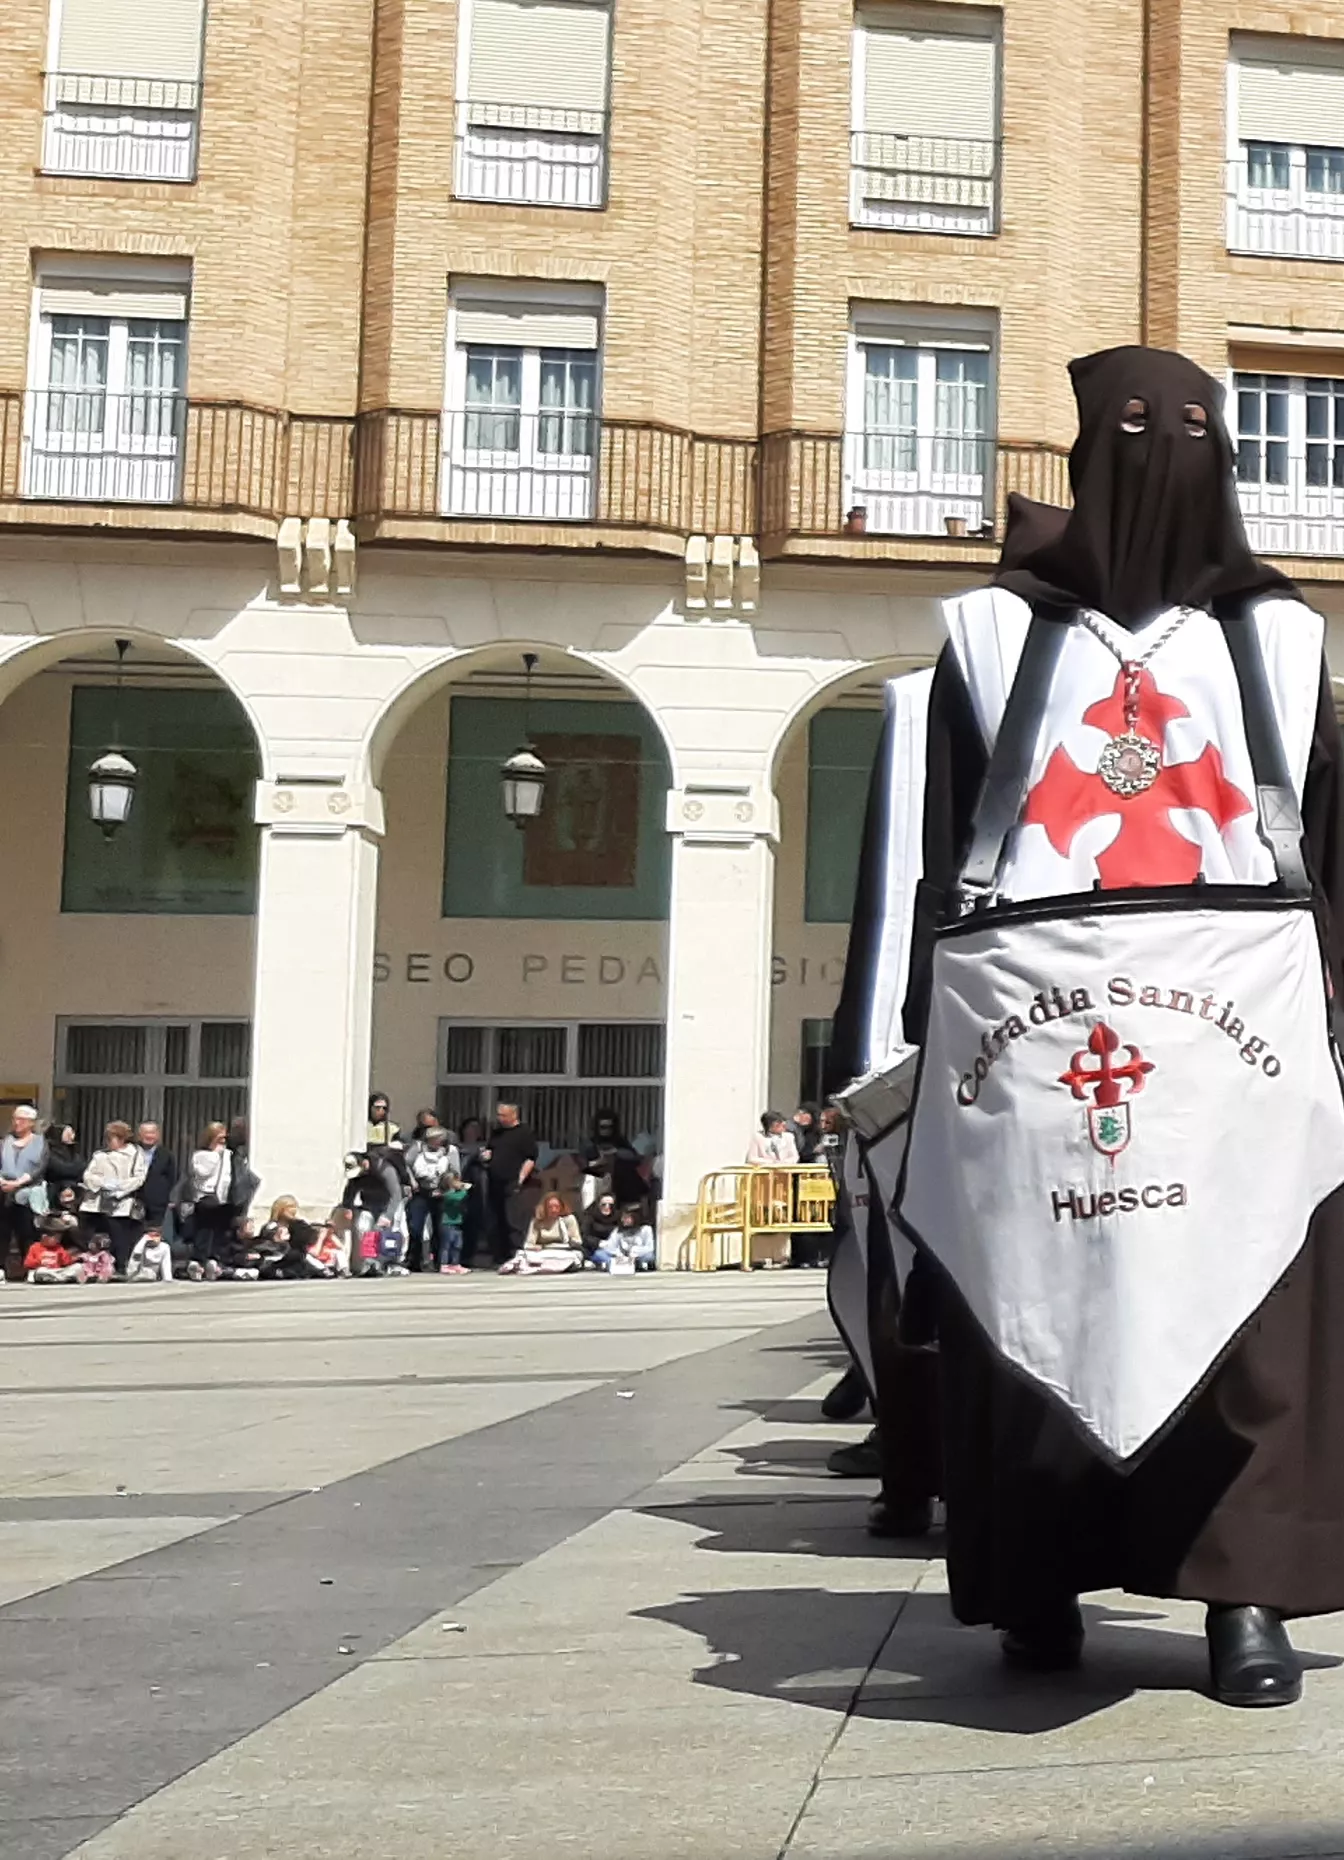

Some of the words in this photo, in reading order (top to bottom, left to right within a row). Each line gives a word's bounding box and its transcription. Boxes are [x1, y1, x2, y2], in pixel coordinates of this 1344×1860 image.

[373, 953, 475, 983] SEO
[957, 985, 1096, 1107] Cofradia
[1107, 976, 1283, 1079] Santiago
[1051, 1180, 1188, 1223] Huesca
